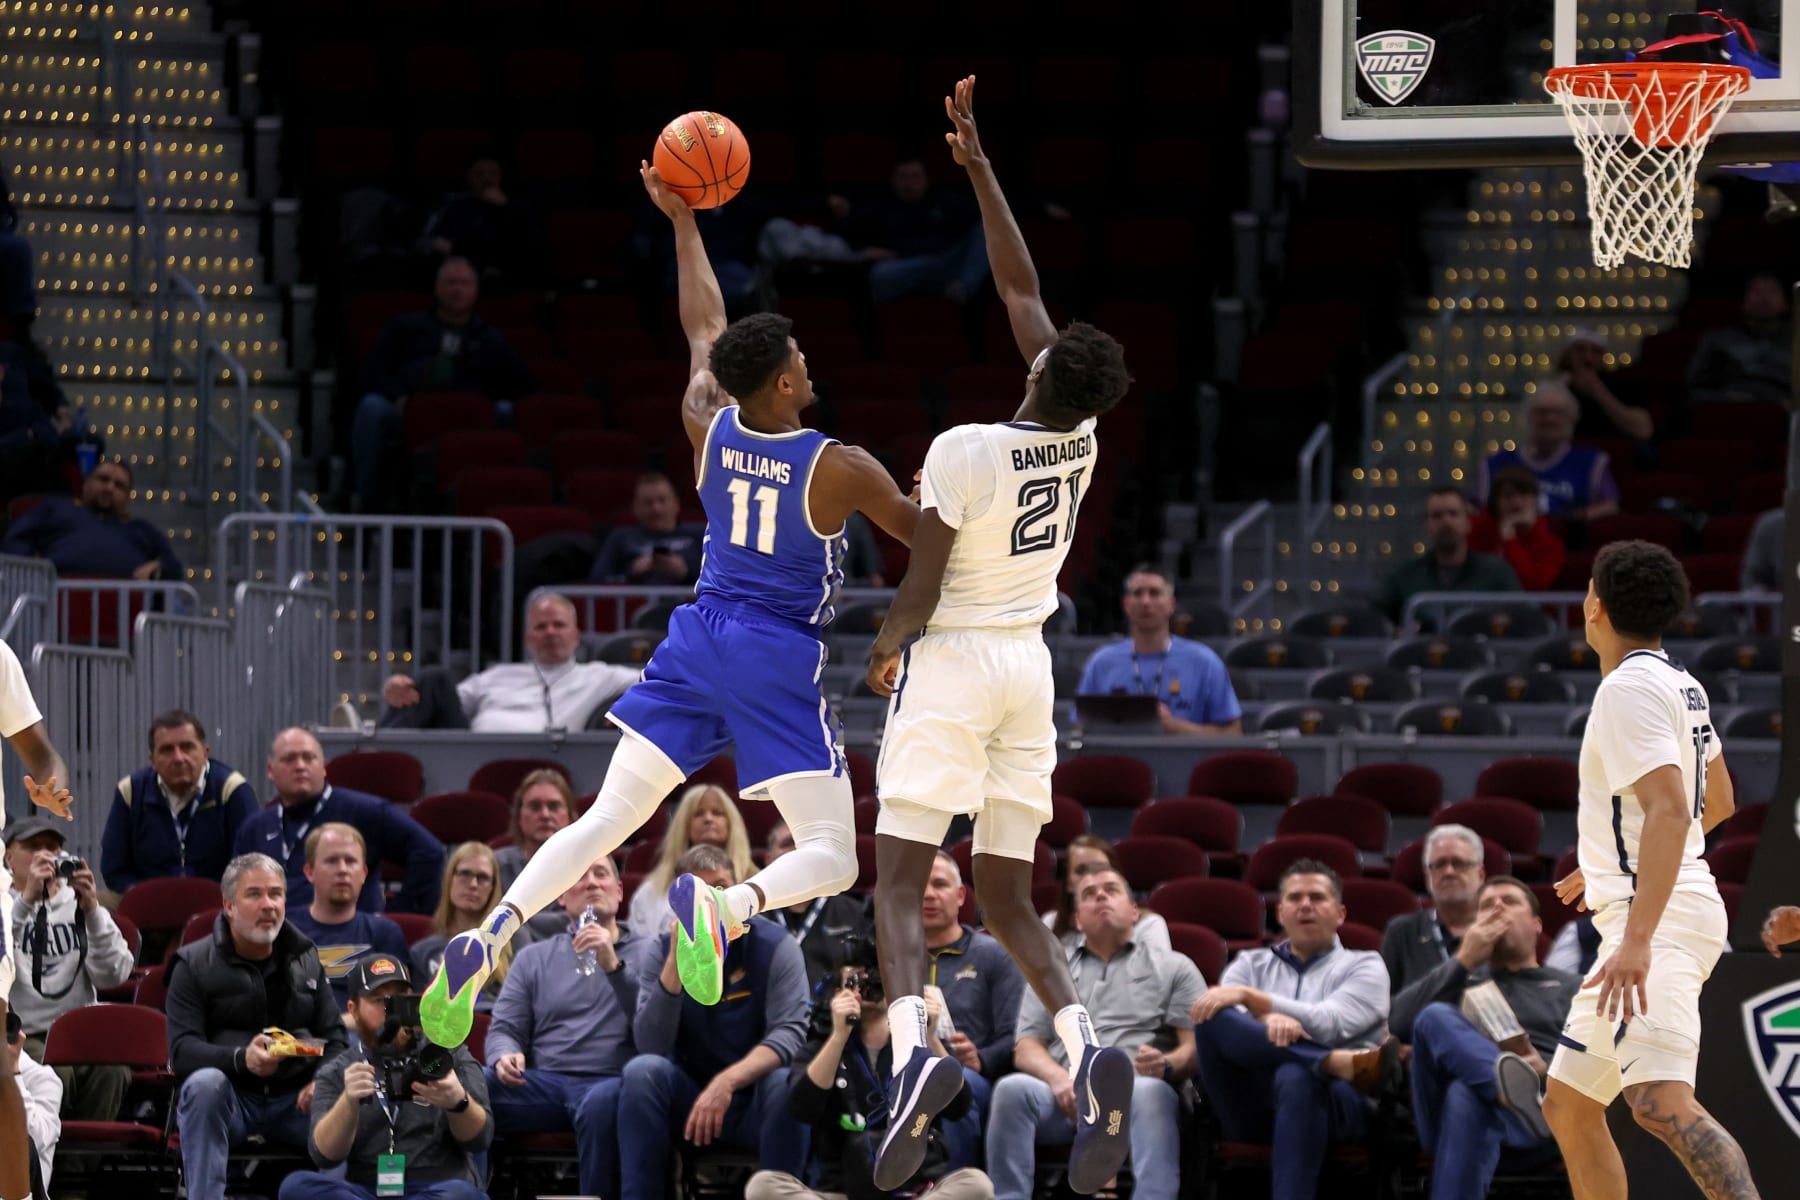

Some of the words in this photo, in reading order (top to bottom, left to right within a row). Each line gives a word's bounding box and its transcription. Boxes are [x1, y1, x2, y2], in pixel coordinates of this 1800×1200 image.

[1363, 55, 1426, 71] MAC
[721, 446, 791, 485] WILLIAMS
[1011, 434, 1092, 471] BANDAOGO
[727, 477, 780, 556] 11
[1009, 466, 1087, 557] 21
